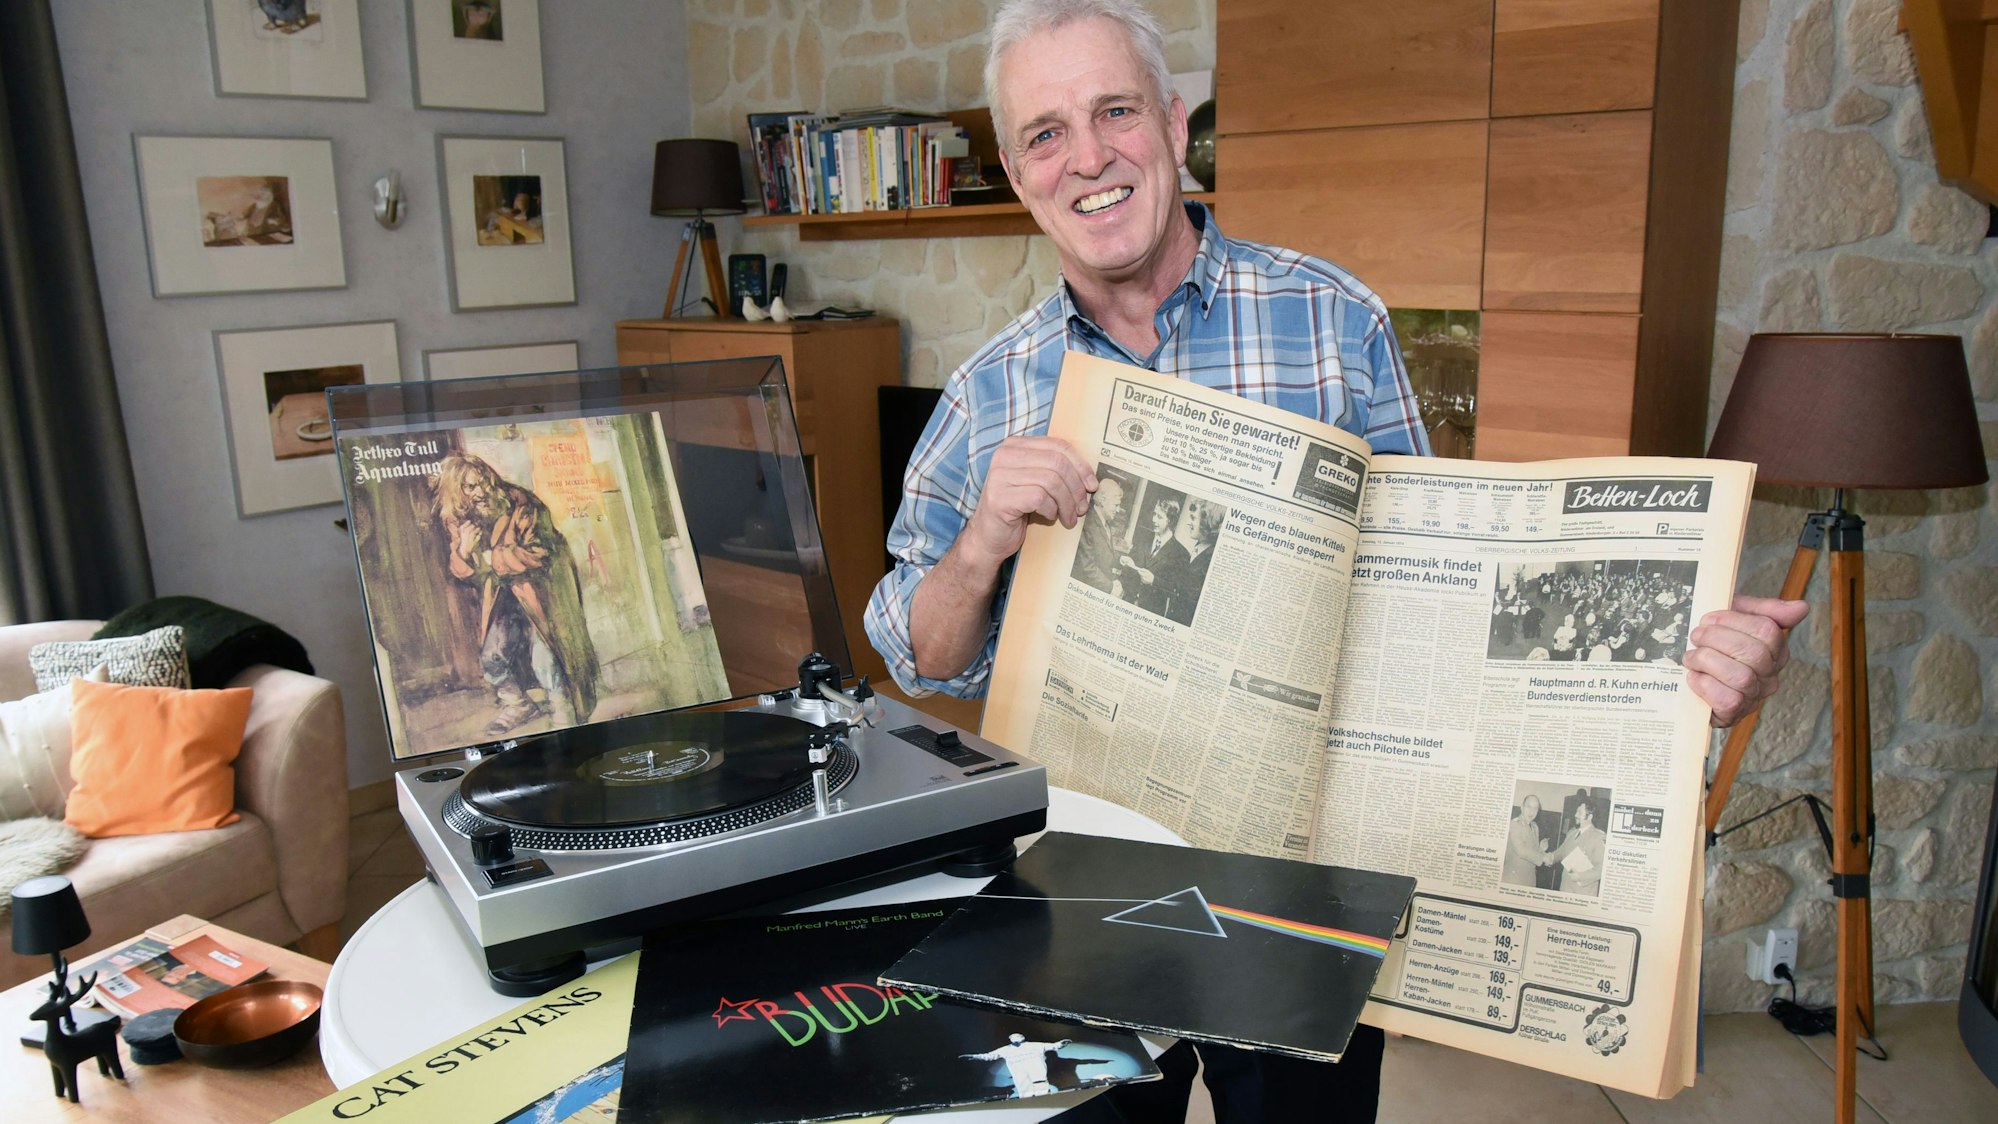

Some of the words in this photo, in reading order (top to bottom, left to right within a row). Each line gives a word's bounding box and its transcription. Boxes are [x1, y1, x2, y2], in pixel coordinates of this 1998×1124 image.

[1124, 385, 1168, 410] Darauf
[1169, 400, 1207, 423] haben
[1210, 410, 1230, 429] Sie
[1232, 421, 1301, 450] gewartet!
[1122, 402, 1138, 414] Das
[1140, 408, 1156, 419] sind
[1158, 412, 1183, 429] Preise,
[1186, 423, 1200, 434] von
[1202, 427, 1228, 442] denen
[1231, 438, 1250, 449] man
[1252, 444, 1284, 459] spricht.
[352, 444, 402, 463] Jethro
[404, 440, 438, 457] Tull
[1161, 444, 1169, 452] zu
[1170, 446, 1179, 454] 50
[1188, 452, 1212, 466] billiger
[1162, 436, 1178, 447] jetzt
[1200, 446, 1208, 455] 25
[1220, 452, 1227, 462] ja
[1228, 456, 1250, 471] sogar
[1252, 463, 1262, 472] bis
[1166, 428, 1189, 441] Unsere
[1190, 435, 1234, 455] hochwertige
[1236, 450, 1276, 469] Bekleidung
[354, 461, 443, 485] Aqualung
[1172, 454, 1190, 465] sollten
[1192, 462, 1201, 470] Sie
[1204, 465, 1215, 474] sich
[1218, 471, 1237, 481] einmal
[1240, 477, 1265, 490] ansehen.
[1318, 465, 1357, 487] GREKO
[1367, 474, 1382, 485] hte
[1385, 474, 1473, 490] Sonderleistungen
[1477, 481, 1489, 491] im
[1492, 483, 1523, 492] neuen
[1526, 482, 1553, 493] Jahr!
[1212, 486, 1264, 508] OBERBERGISCHE
[1266, 504, 1314, 523] VOLKS-ZEITUNG
[1568, 484, 1702, 509] Betten-Loch
[1230, 508, 1266, 528] Wegen
[1268, 519, 1286, 534] des
[1289, 526, 1321, 545] blauen
[1322, 536, 1346, 553] Kittels
[1422, 520, 1441, 529] 19,90
[1658, 524, 1668, 534] P
[1225, 521, 1240, 533] ins
[1242, 527, 1295, 550] Gefängnis
[1297, 546, 1335, 563] gesperrt
[1475, 546, 1527, 554] OBERBERGISCHE
[1530, 546, 1575, 554] VOLKS-ZEITUNG
[1443, 559, 1483, 573] findet
[1352, 569, 1371, 579] etzt
[1373, 570, 1420, 584] großen
[1422, 572, 1478, 590] Anklang
[1067, 582, 1104, 606] Disko-Abend
[1105, 599, 1115, 609] für
[1116, 606, 1133, 617] einen
[1134, 612, 1153, 625] guten
[1154, 620, 1176, 634] Zweck
[1056, 625, 1071, 639] Das
[1072, 632, 1115, 659] Lehrthema
[1116, 651, 1128, 664] ist
[1128, 657, 1144, 671] der
[1146, 664, 1169, 682] Wald
[1530, 678, 1585, 689] Hauptmann
[1588, 678, 1597, 689] d.
[1600, 679, 1609, 689] R.
[1612, 680, 1640, 690] Kuhn
[1641, 682, 1678, 692] erhielt
[1042, 692, 1054, 703] Die
[1056, 696, 1089, 722] Sozialtarife
[1527, 691, 1642, 704] Bundesverdienstorden
[1326, 737, 1344, 749] jetzt
[1346, 740, 1371, 752] auch
[1374, 743, 1409, 756] Piloten
[1412, 749, 1431, 759] aus
[1329, 726, 1411, 745] Volkshochschule
[1414, 736, 1443, 749] bildet
[1614, 806, 1633, 814] möbel
[1458, 844, 1485, 852] Beratungen
[1467, 852, 1498, 862] Dachverband
[1622, 850, 1647, 859] diskutiert
[1608, 856, 1646, 866] Verkehrslinien
[767, 922, 822, 933] Manfred
[825, 918, 869, 928] Mann's
[872, 914, 908, 924] Earth
[911, 910, 944, 919] Band
[1417, 916, 1442, 926] Damen-
[1418, 906, 1466, 921] Damen-Mäntel
[1498, 916, 1522, 931] 169,-
[1414, 924, 1444, 936] Kostüme
[1495, 934, 1519, 951] 149,-
[1547, 927, 1558, 935] Eine
[1560, 929, 1587, 939] besondere
[1588, 934, 1613, 944] Leistung:
[1547, 934, 1610, 953] Herren-Hosen
[1412, 939, 1463, 955] Damen-Jacken
[1493, 950, 1517, 966] 139,-
[1409, 958, 1460, 976] Herren-Anzüge
[1489, 970, 1514, 987] 169,-
[1404, 983, 1430, 994] Herren-
[1406, 973, 1455, 990] Herren-Mäntel
[1486, 986, 1511, 1002] 149,-
[1598, 980, 1620, 995] 49,-
[755, 982, 939, 1047] BUDAP
[1404, 991, 1451, 1009] Kaban-Jacken
[1487, 1005, 1508, 1021] 89,-
[1525, 994, 1585, 1013] GUMMERSBACH
[1520, 1024, 1567, 1041] DERSCHLAG
[332, 1069, 425, 1119] CAT
[425, 986, 603, 1075] STEVENS
